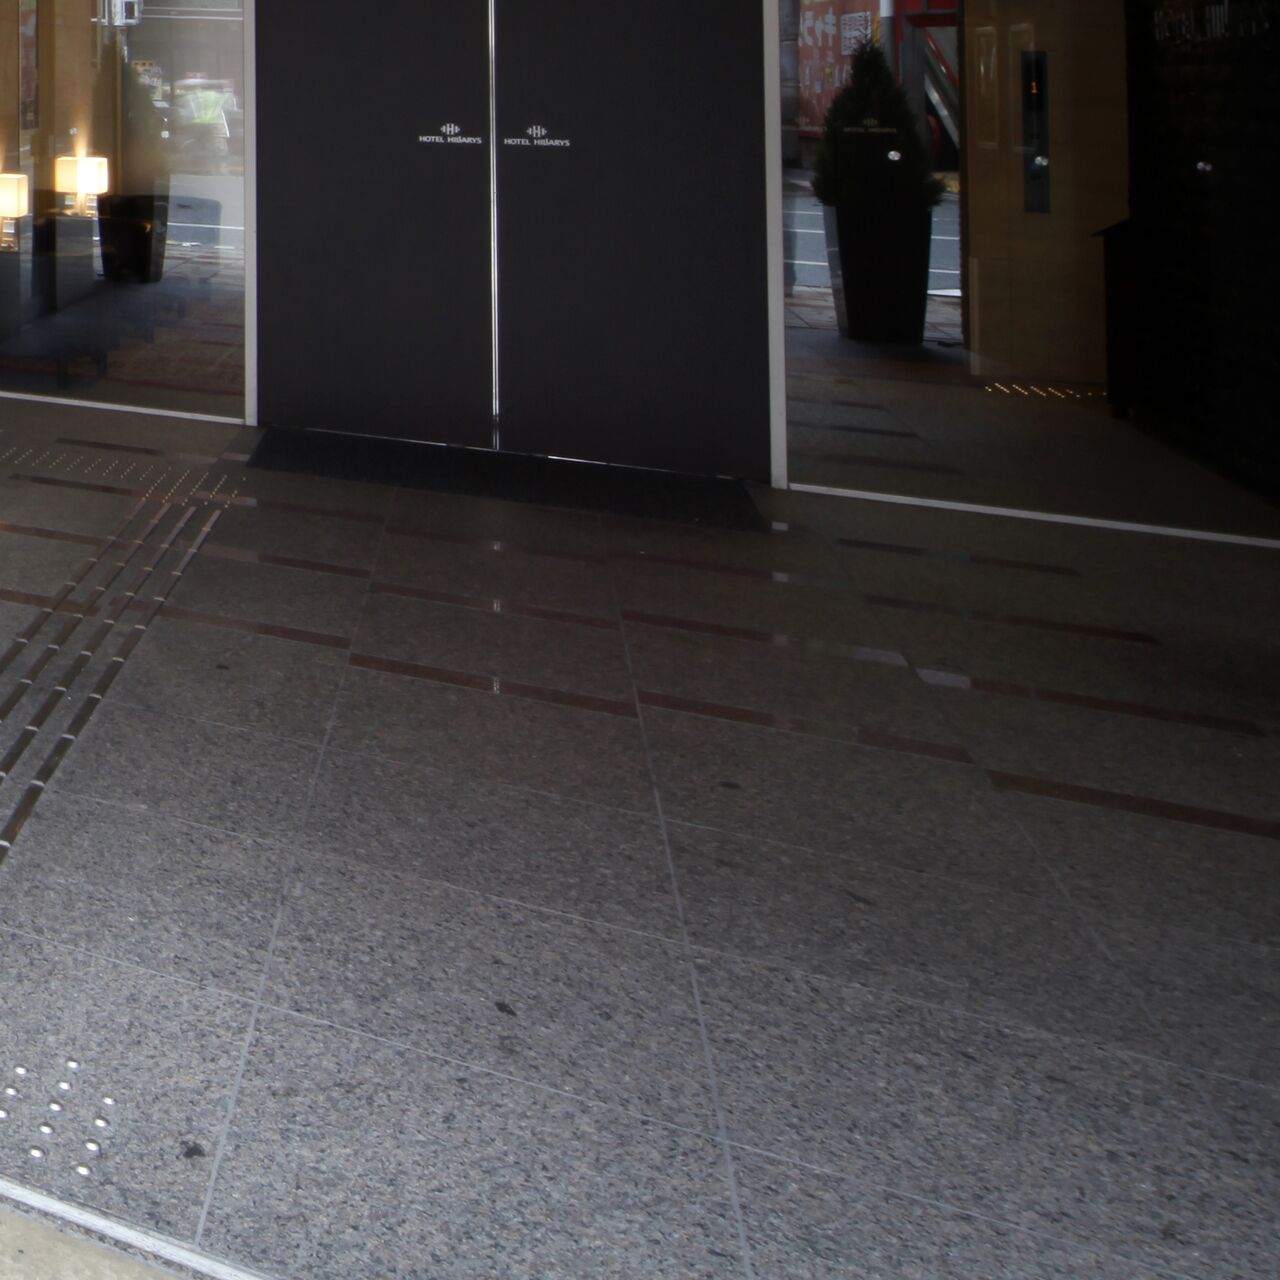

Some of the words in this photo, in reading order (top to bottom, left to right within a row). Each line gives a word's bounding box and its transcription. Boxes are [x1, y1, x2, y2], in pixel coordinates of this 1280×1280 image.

[419, 135, 444, 143] HOTEL
[447, 136, 482, 144] HILLARYS
[504, 138, 531, 146] HOTEL
[534, 138, 570, 147] HILLARYS
